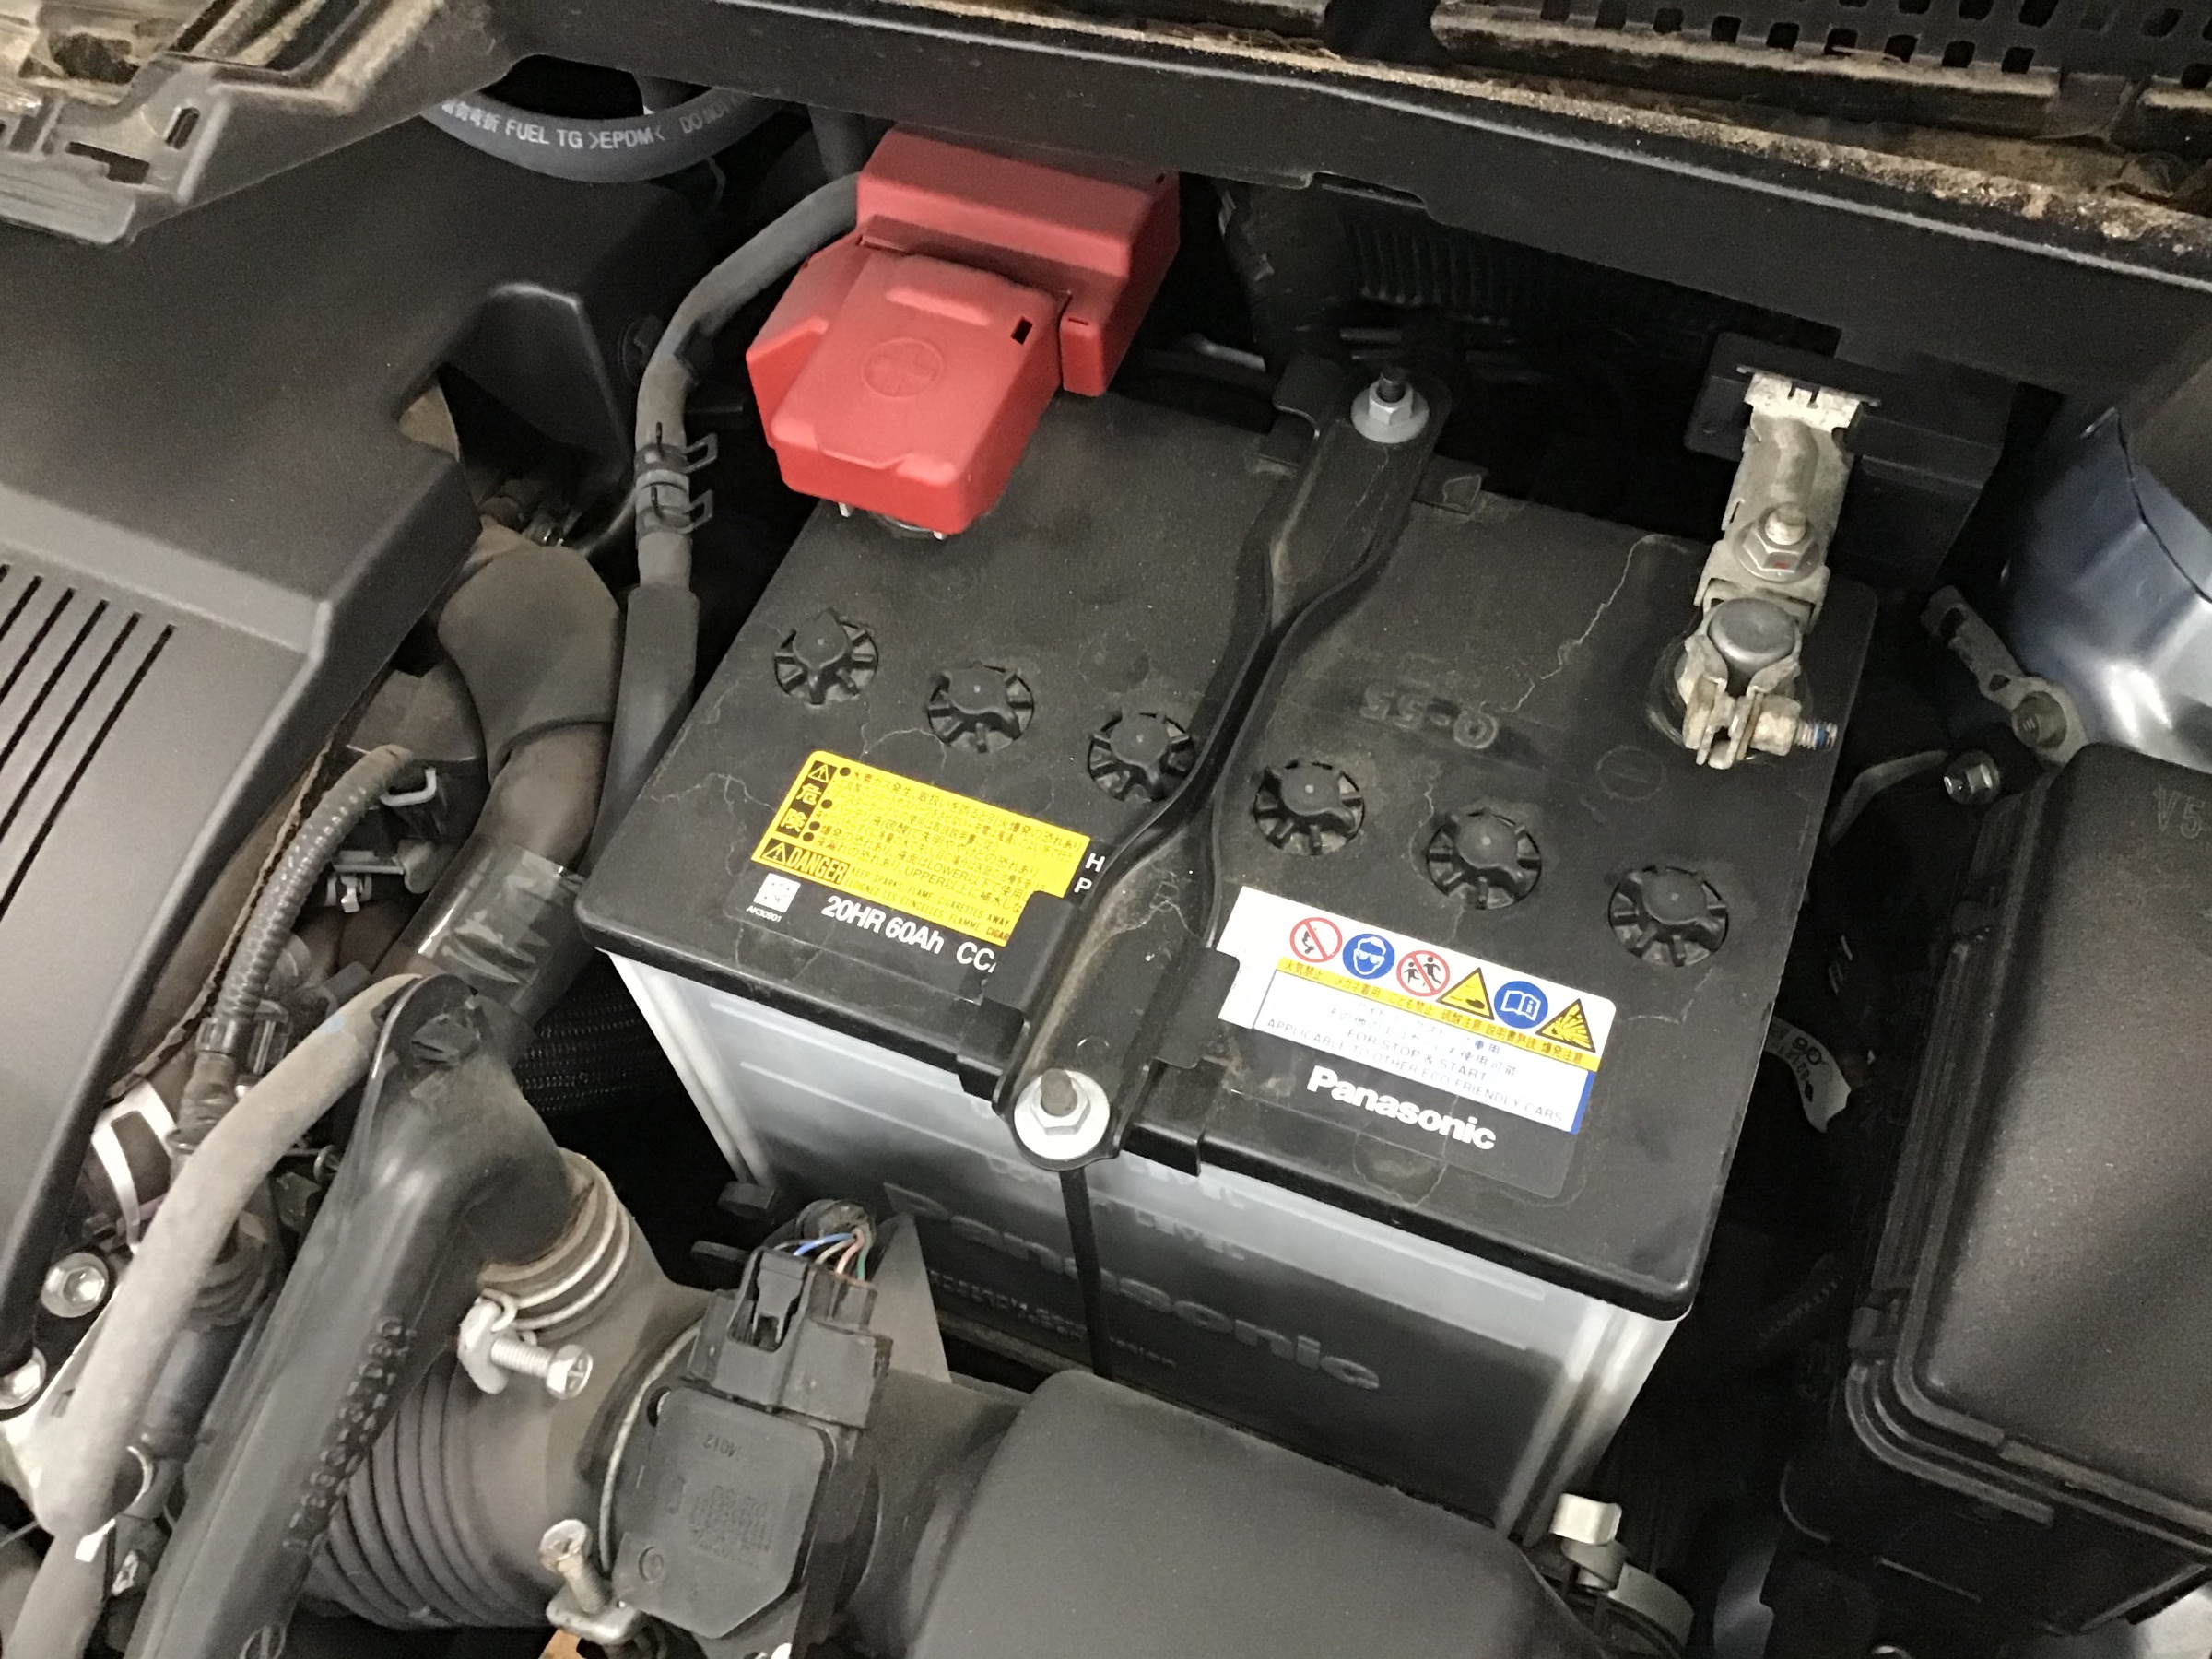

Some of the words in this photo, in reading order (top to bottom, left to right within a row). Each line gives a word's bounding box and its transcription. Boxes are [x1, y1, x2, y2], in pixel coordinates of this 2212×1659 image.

[506, 119, 550, 144] FUEL
[556, 129, 582, 149] TG
[781, 783, 821, 830] 危険
[784, 847, 850, 883] DANGER
[1073, 877, 1093, 895] P
[1085, 852, 1106, 872] H
[820, 894, 884, 933] 20HR
[885, 919, 945, 955] 60Ah
[956, 941, 997, 974] CC
[1284, 958, 1323, 981] 火気禁止
[1335, 974, 1381, 999] メガネ着用
[1540, 1040, 1583, 1065] 爆発注意
[1347, 1028, 1377, 1046] FOR
[1381, 1038, 1419, 1060] STOP
[1424, 1053, 1433, 1064] &
[1438, 1057, 1487, 1082] START
[1306, 1065, 1498, 1151] Panasonic
[1371, 1050, 1418, 1076] OTHER
[1420, 1066, 1450, 1086] ECO
[1453, 1077, 1521, 1109] FRIENDLY
[1524, 1100, 1563, 1123] CARS
